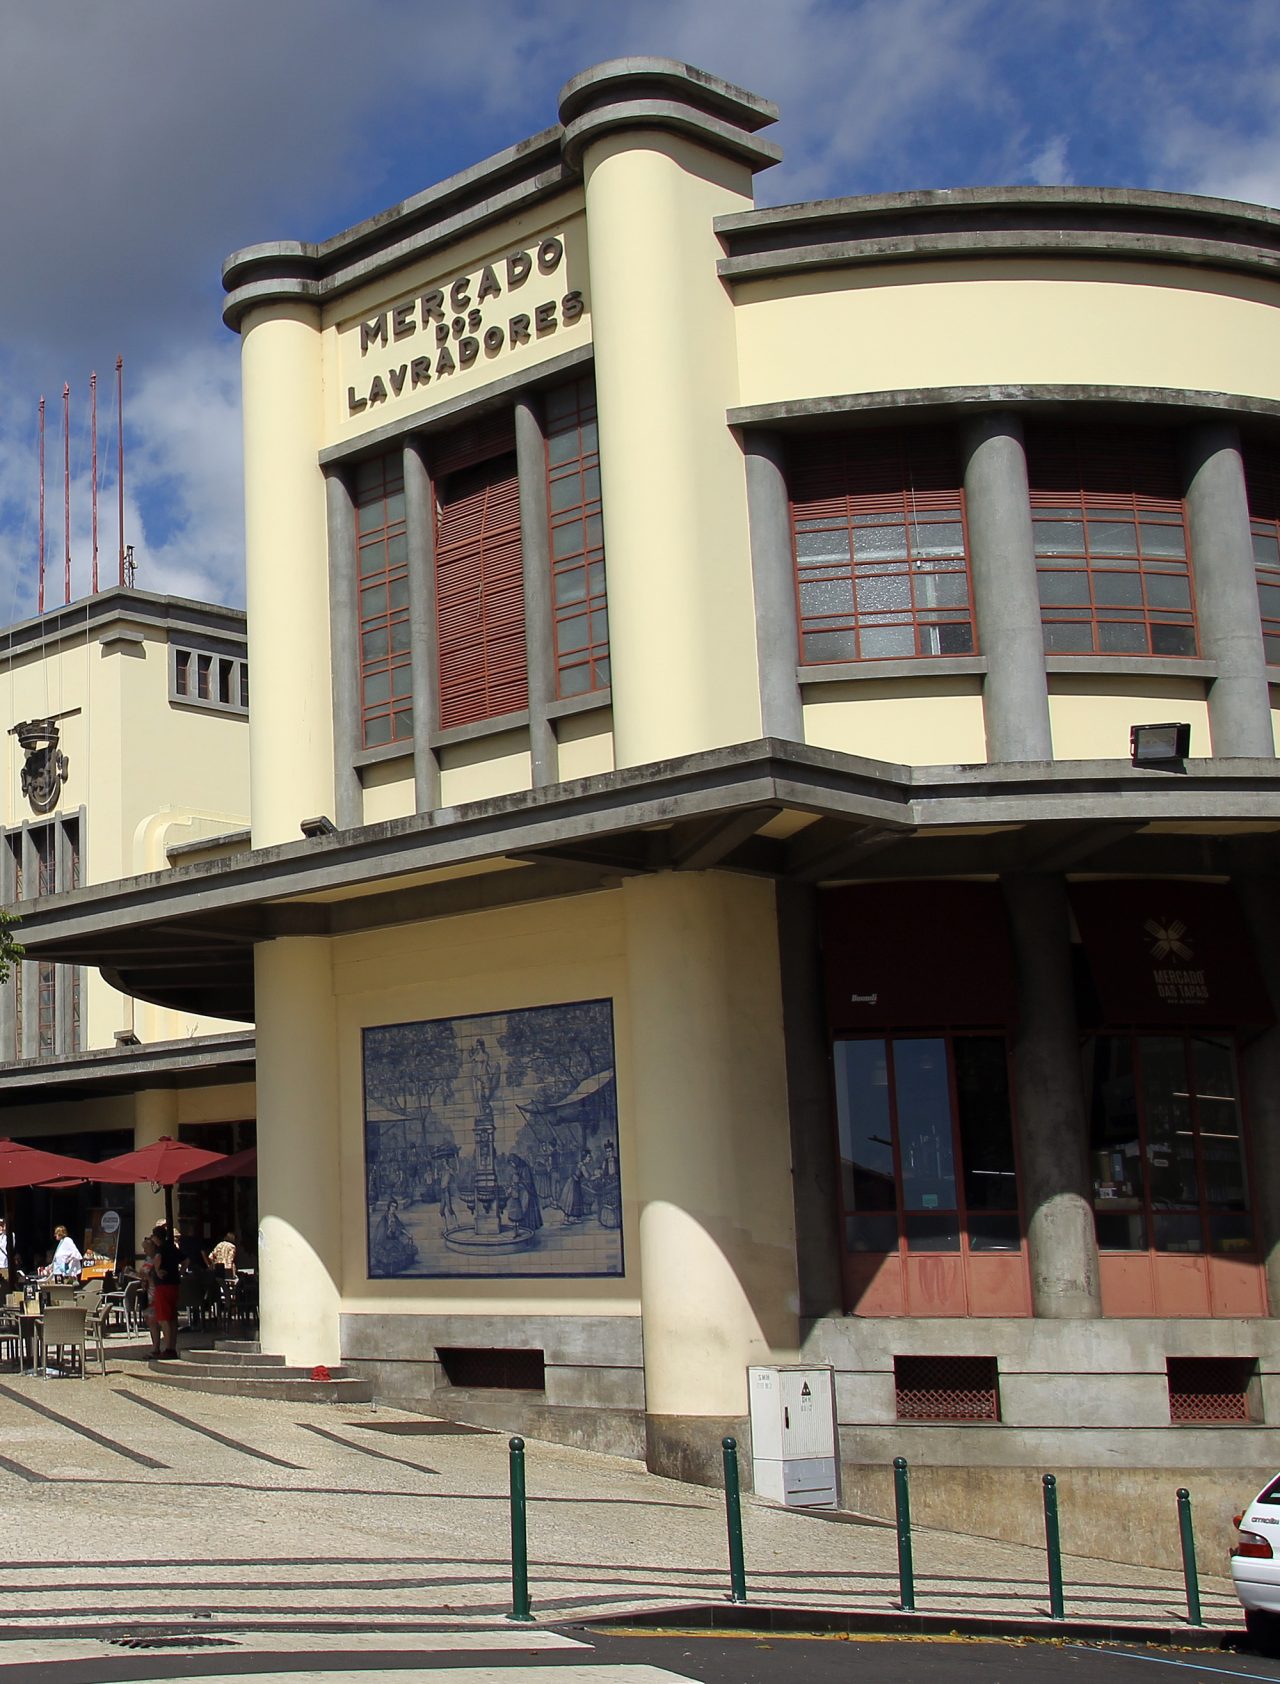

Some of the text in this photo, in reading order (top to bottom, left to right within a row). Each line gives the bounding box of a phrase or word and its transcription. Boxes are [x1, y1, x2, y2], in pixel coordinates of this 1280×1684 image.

[360, 237, 564, 353] MERCADO
[435, 308, 482, 347] DOS
[347, 290, 585, 412] LAVRADORES
[1153, 969, 1206, 985] MERCADO
[1157, 984, 1209, 999] DAS TAPAS
